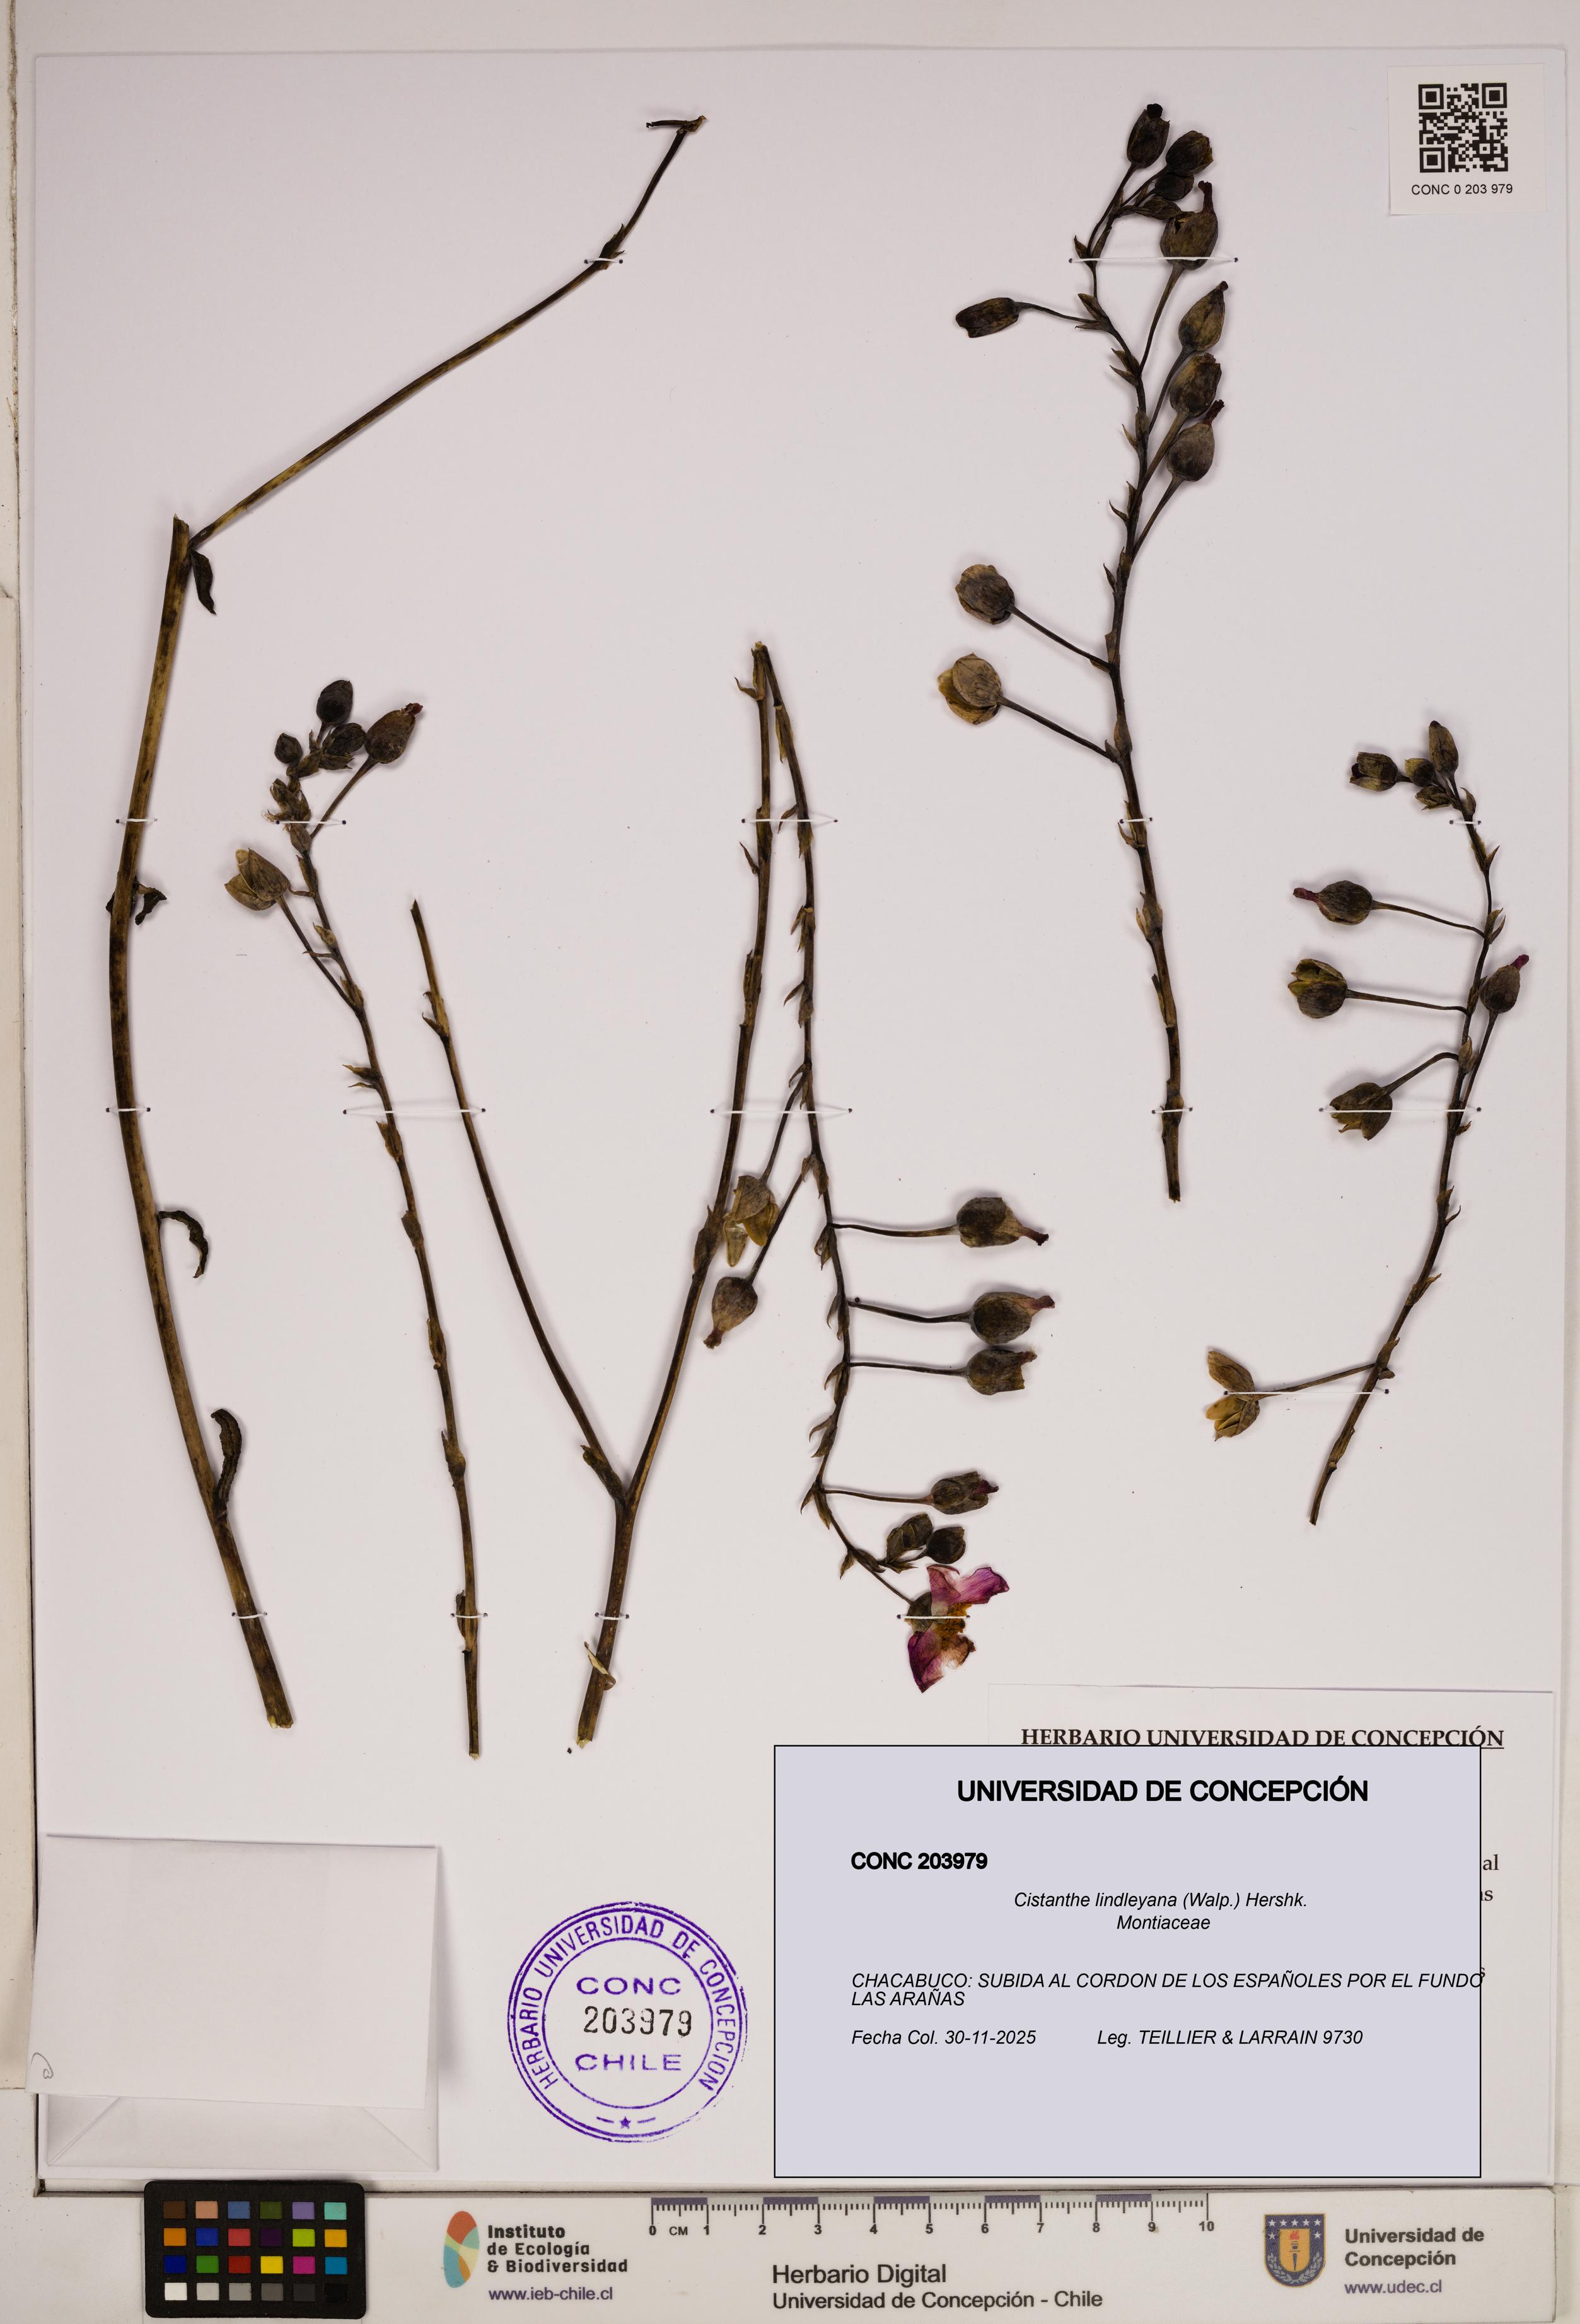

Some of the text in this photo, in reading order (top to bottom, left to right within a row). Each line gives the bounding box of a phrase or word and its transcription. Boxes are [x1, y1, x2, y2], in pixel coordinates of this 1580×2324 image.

[1412, 183, 1513, 195] CONC 0 203 979
[1021, 1726, 1504, 1746] HERBARIO UNIVERSIDAD DE CONCEPCIÓN
[576, 1977, 681, 1996] CONC
[519, 1914, 736, 2091] HERBARIO UNIVERSIDAD DE CONCEPCION
[583, 2006, 692, 2037] 203979
[574, 2053, 682, 2071] CHILE
[487, 2224, 566, 2239] Instituto
[649, 2221, 1215, 2236] 0 CM 1 2 3 4 5 6 7 8 9 10
[1345, 2227, 1485, 2244] Universidad de
[486, 2240, 590, 2258] de Ecología
[487, 2258, 629, 2273] & Biodiversidad
[1344, 2250, 1456, 2270] Concepción
[772, 2263, 947, 2289] Herbario Digital
[488, 2286, 613, 2301] www.ieb-chile.cl
[1344, 2279, 1443, 2294] www.udec.cl
[772, 2291, 885, 2310] Universidad
[891, 2291, 916, 2309] de
[921, 2291, 1035, 2311] Concepción
[1054, 2290, 1104, 2308] Chile
